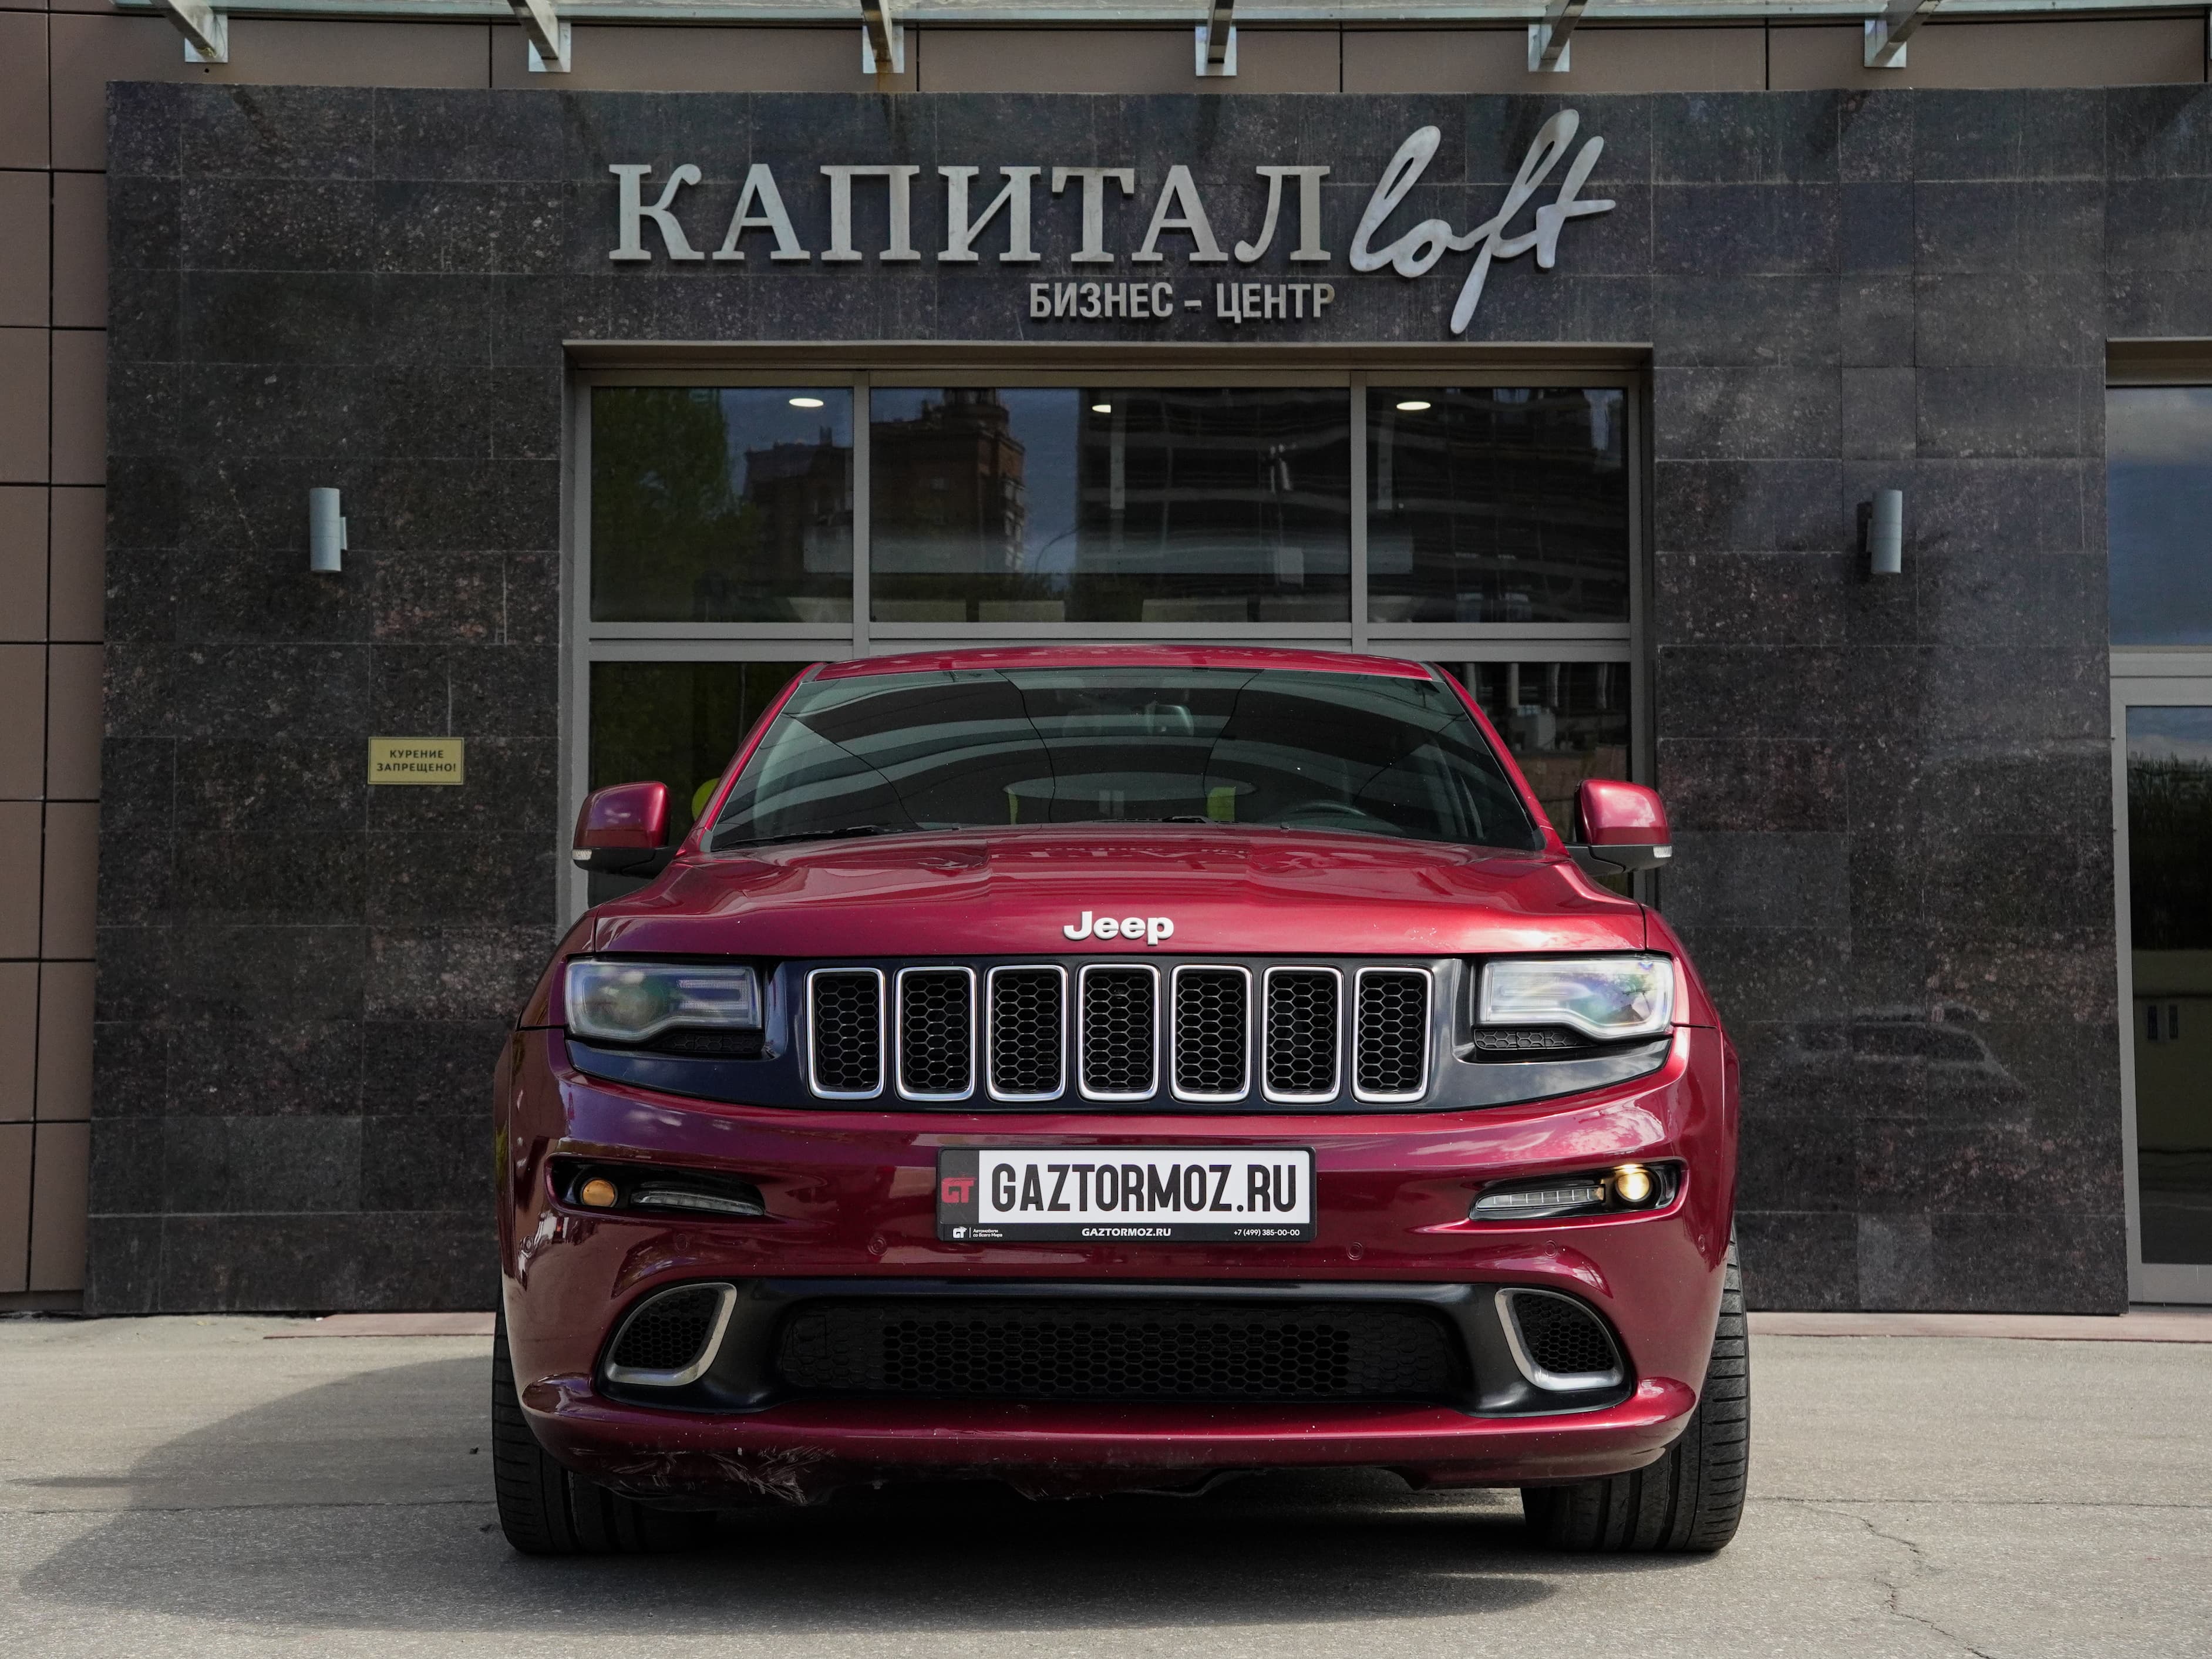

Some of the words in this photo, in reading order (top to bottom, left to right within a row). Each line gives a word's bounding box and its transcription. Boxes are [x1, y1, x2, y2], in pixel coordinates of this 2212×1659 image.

[608, 163, 1331, 263] КАПИТАЛ
[1349, 109, 1616, 334] loft
[1030, 282, 1173, 319] БИЗНЕС
[1217, 282, 1335, 324] ЦЕНТР
[377, 763, 456, 773] ЗАПРЕЩЕНО!
[390, 750, 444, 758] КУРЕНИЕ
[1063, 911, 1174, 945] Jeep
[941, 1177, 975, 1203] GT
[992, 1163, 1297, 1212] GAZTORMOZ.RU
[1082, 1228, 1171, 1237] GAZTORMOZ.RU
